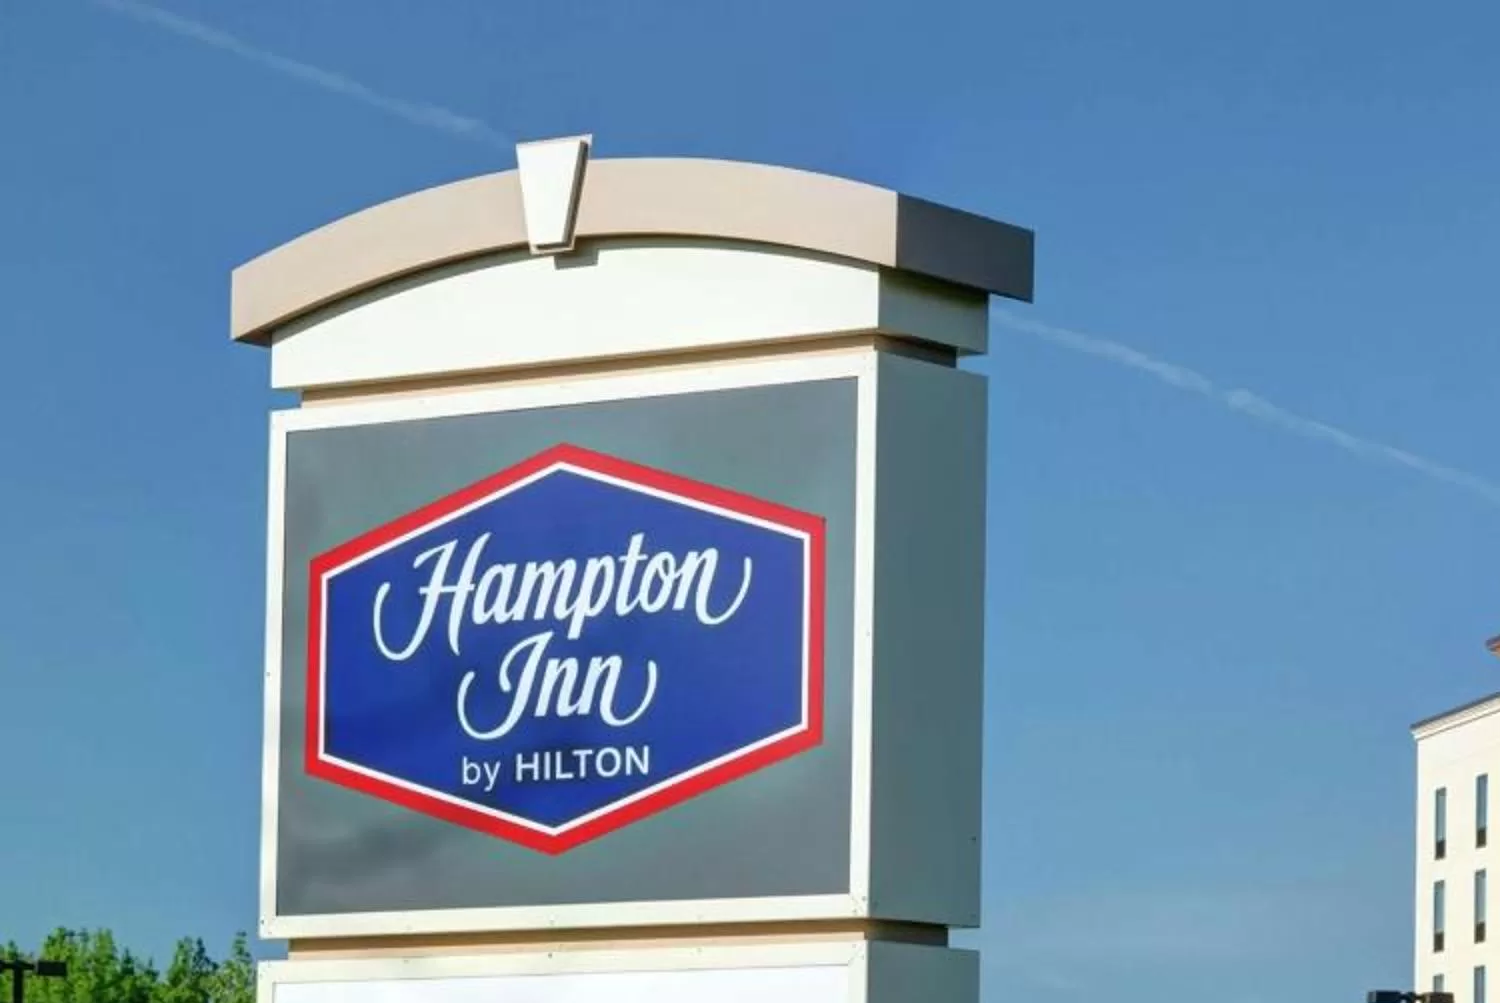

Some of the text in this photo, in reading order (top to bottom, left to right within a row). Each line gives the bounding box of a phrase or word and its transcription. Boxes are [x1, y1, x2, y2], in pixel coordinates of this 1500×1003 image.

[373, 532, 752, 661] Hampton
[457, 631, 657, 740] Inn
[462, 745, 650, 791] by HILTON
